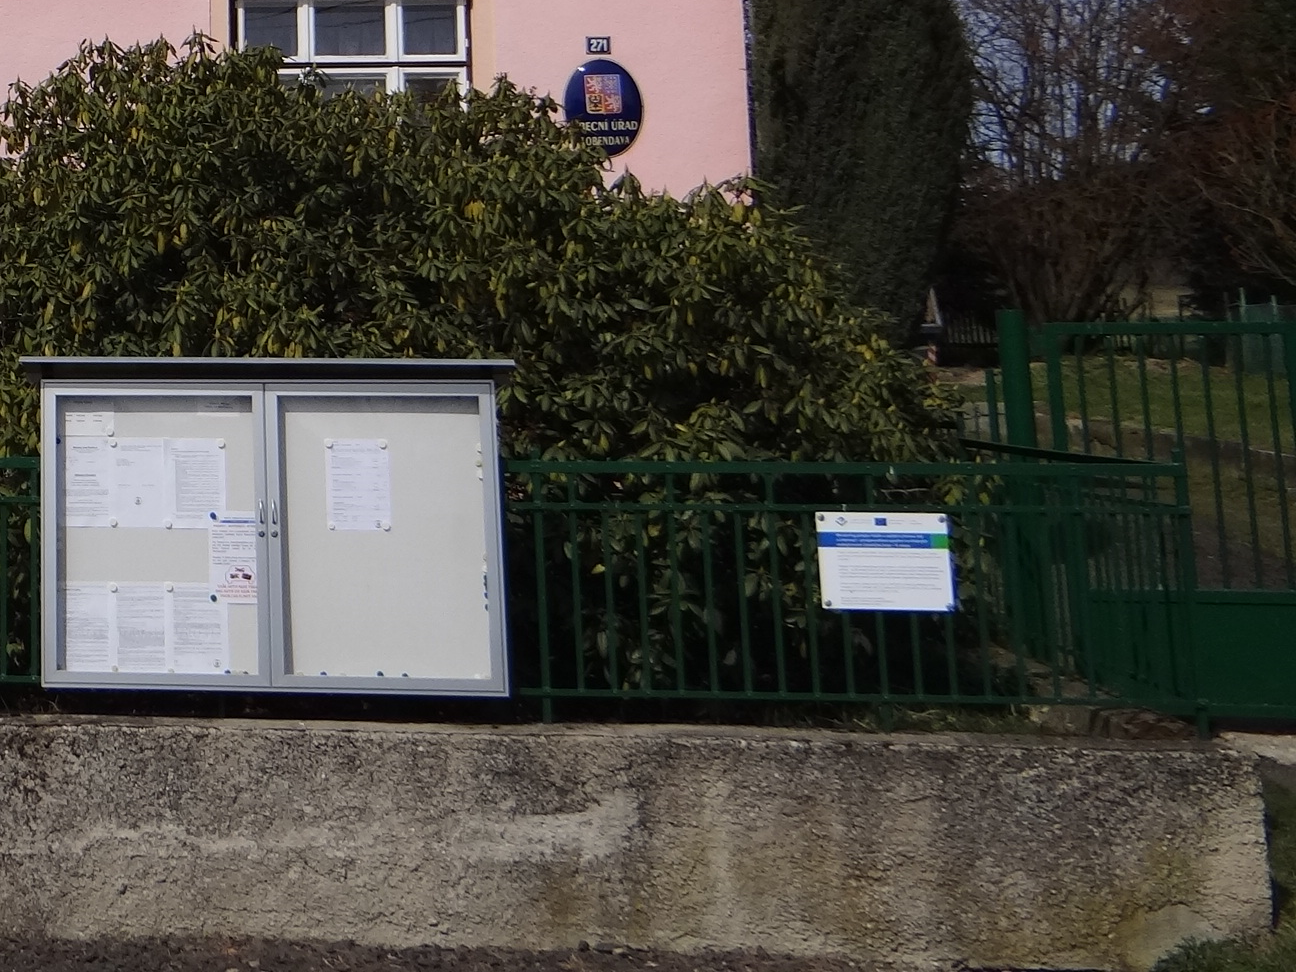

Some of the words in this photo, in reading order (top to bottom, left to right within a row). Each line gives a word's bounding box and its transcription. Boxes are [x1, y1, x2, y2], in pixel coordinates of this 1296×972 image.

[590, 39, 608, 52] 271
[610, 118, 639, 131] ÚŘAD
[581, 135, 630, 146] OBENDAVA
